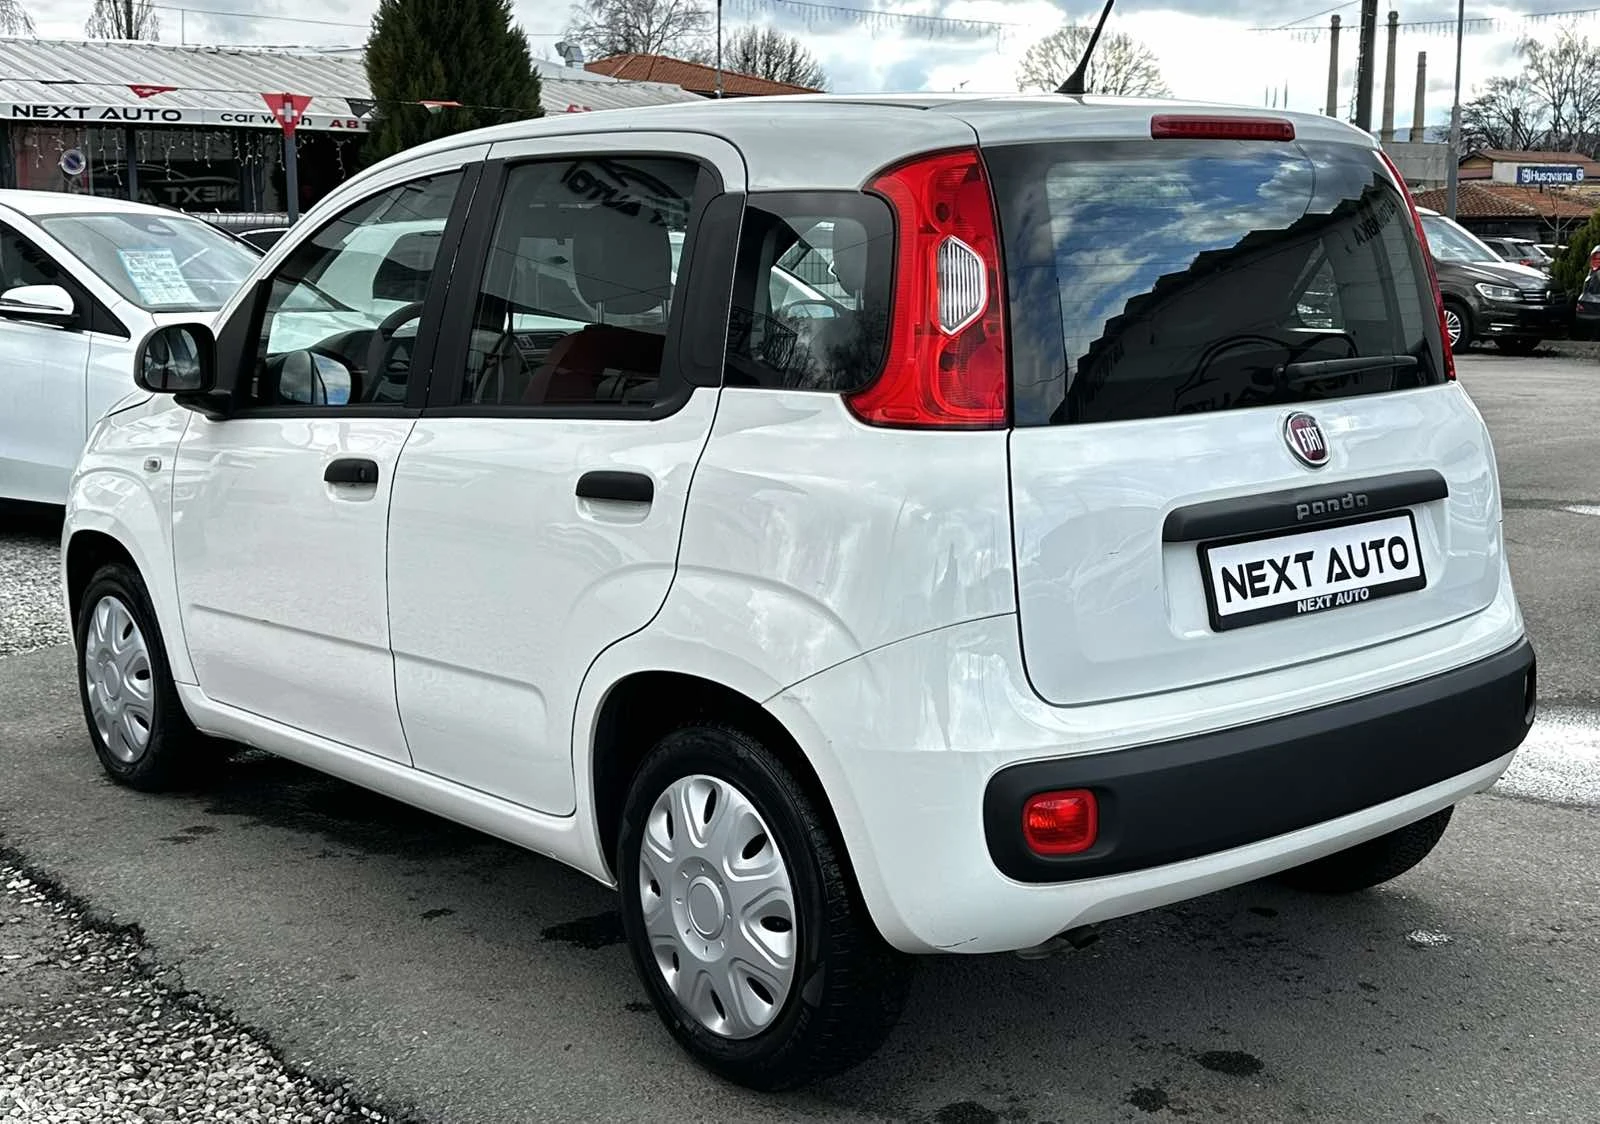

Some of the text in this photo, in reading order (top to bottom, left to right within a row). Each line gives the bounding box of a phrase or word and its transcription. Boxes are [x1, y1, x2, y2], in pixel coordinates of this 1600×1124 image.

[12, 105, 182, 121] NEXT AUTO
[220, 113, 312, 126] car wh
[1531, 170, 1573, 182] Husqvarna
[1296, 426, 1324, 452] FIAT
[1296, 493, 1368, 520] panda
[1221, 536, 1409, 602] NEXT AUTO
[1297, 588, 1369, 613] NEXT AUTO
